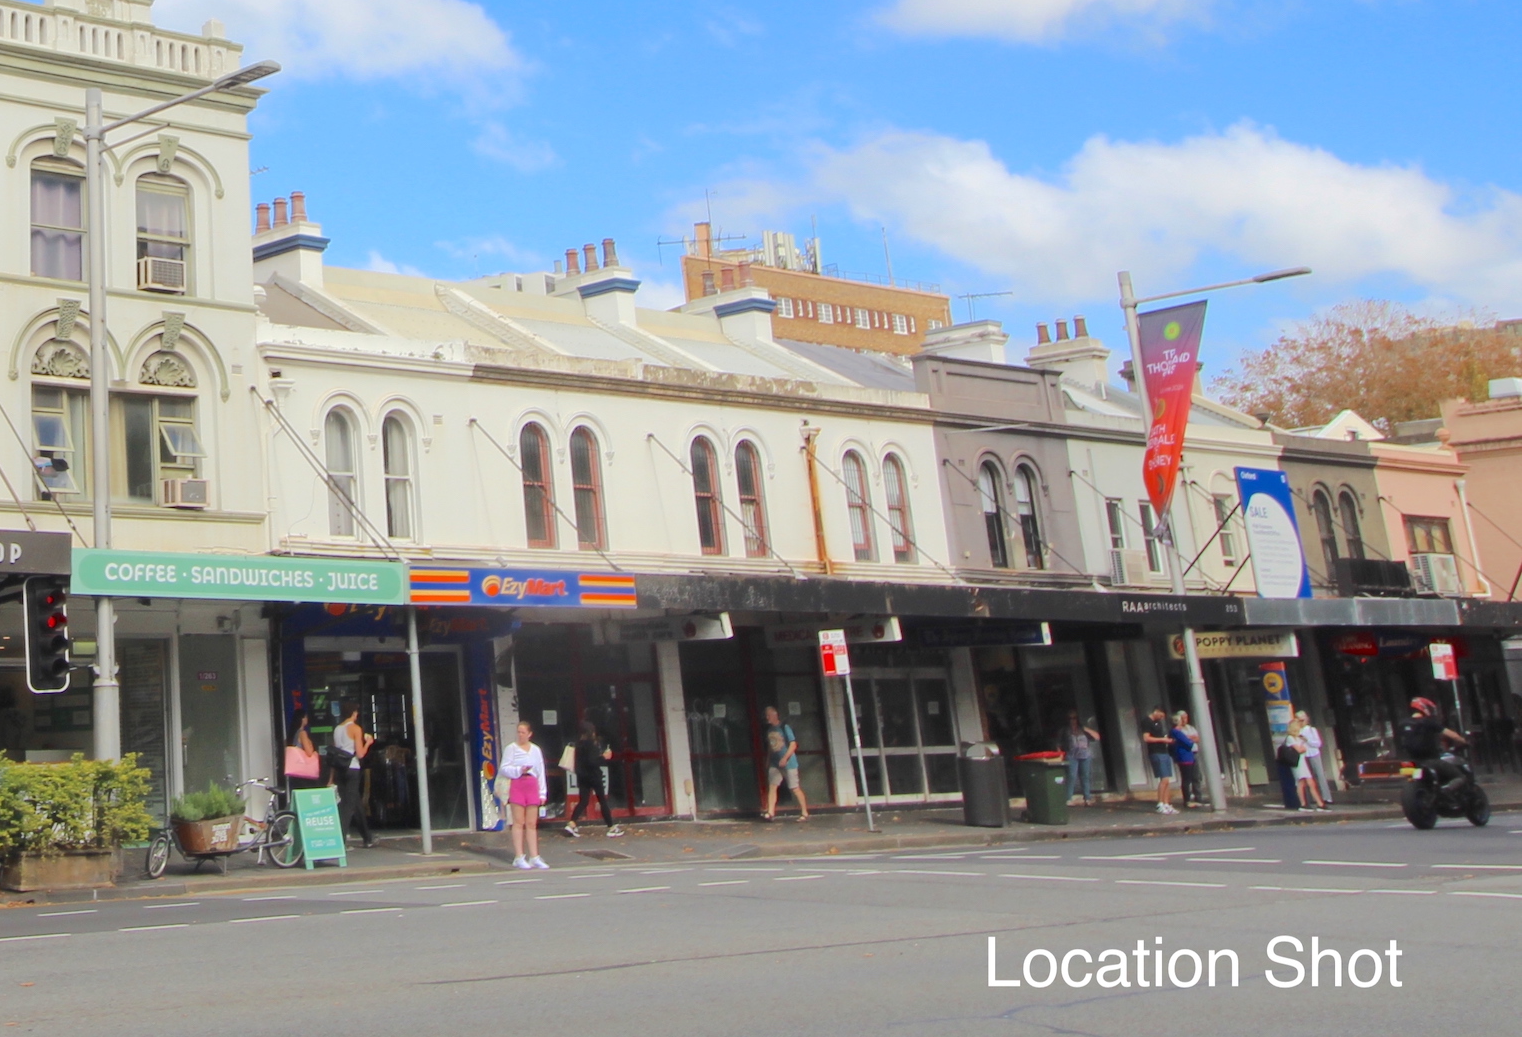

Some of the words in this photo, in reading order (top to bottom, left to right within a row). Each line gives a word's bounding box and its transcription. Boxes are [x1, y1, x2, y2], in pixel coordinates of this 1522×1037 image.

[1249, 506, 1268, 519] SALE
[105, 563, 177, 583] COFFEE
[191, 566, 314, 588] SANDWICHES
[327, 572, 379, 591] JUICE
[500, 576, 566, 600] EzyMart
[1225, 604, 1238, 613] 253
[1196, 637, 1232, 647] POPPY
[1234, 634, 1281, 645] PLANET
[478, 689, 493, 760] EzyMart
[305, 816, 335, 827] REUSE
